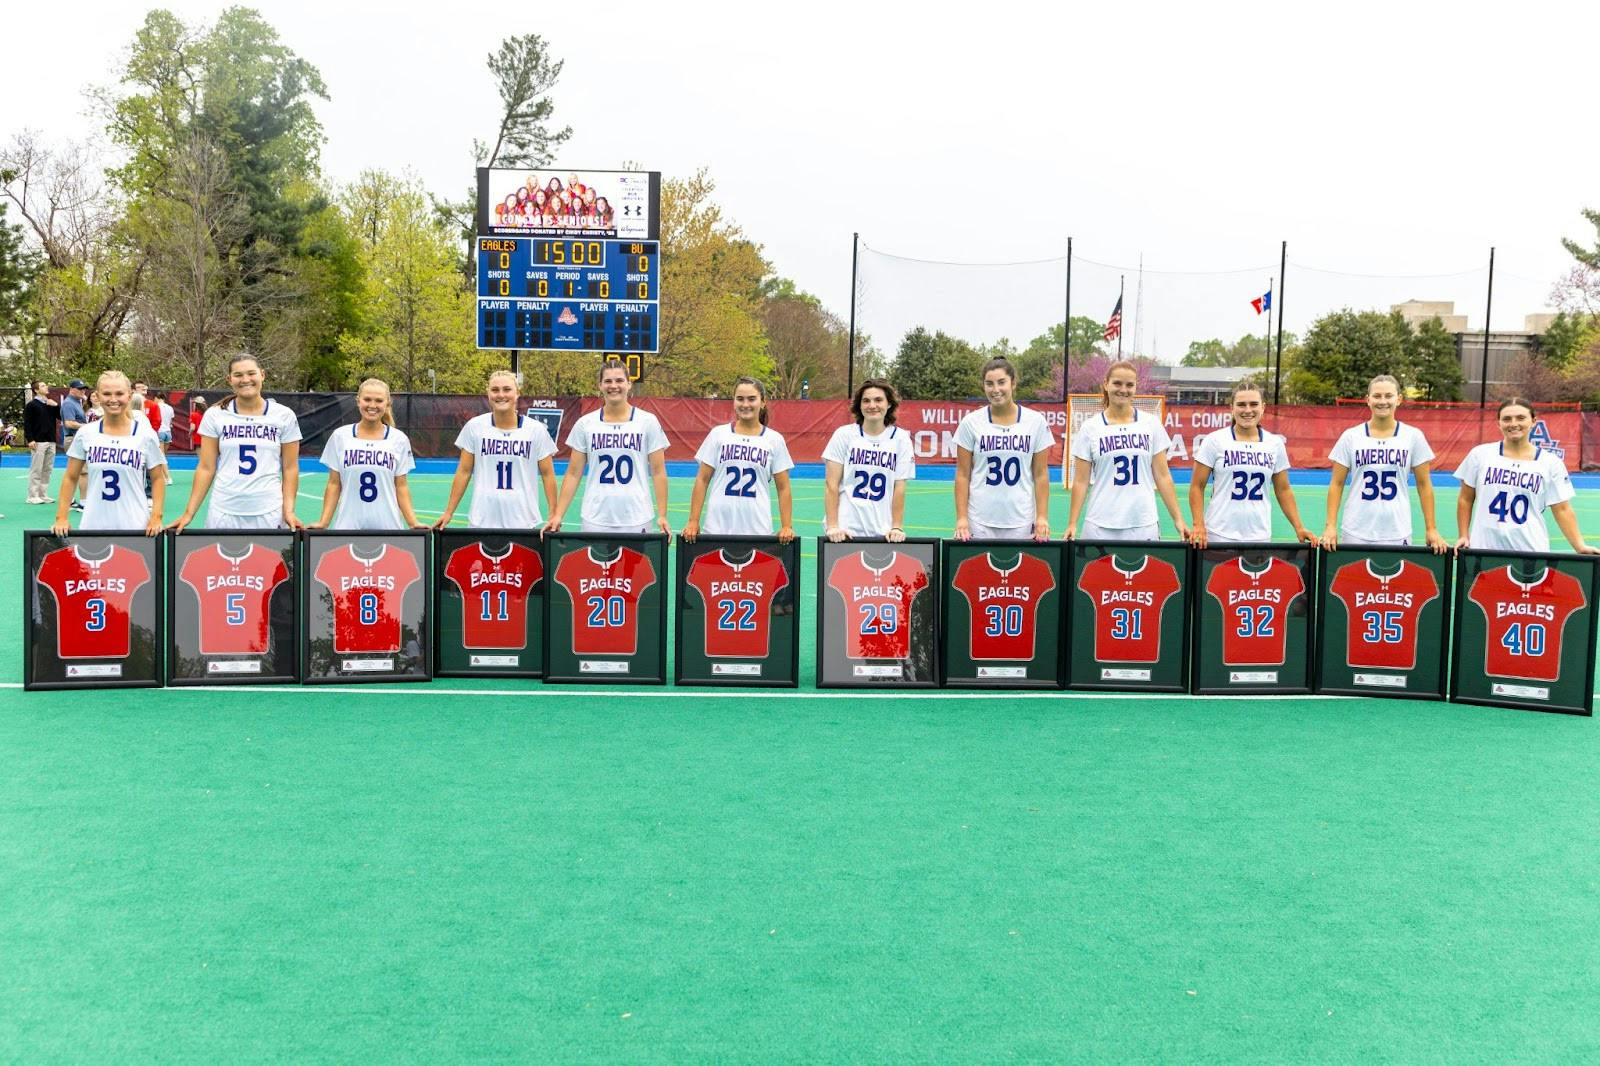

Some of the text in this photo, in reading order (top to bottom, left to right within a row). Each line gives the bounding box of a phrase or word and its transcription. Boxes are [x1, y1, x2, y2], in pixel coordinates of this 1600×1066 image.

[481, 240, 516, 251] EAGLES
[631, 243, 643, 254] BU
[500, 252, 510, 269] 0
[639, 255, 648, 272] 0
[488, 270, 510, 279] SHOTS
[526, 271, 548, 279] SAVES
[556, 272, 580, 280] PERIOD
[587, 272, 609, 280] SAVES
[626, 274, 649, 282] SHOTS
[500, 279, 510, 296] 0
[538, 280, 548, 296] 0
[599, 281, 609, 298] 0
[638, 282, 648, 299] 0
[481, 301, 510, 309] PLAYER
[517, 302, 550, 310] PENALTY
[580, 303, 609, 312] PLAYER
[616, 304, 649, 312] PENALTY
[533, 400, 557, 408] NCAA
[1191, 412, 1233, 428] COMP
[221, 425, 278, 442] AMERICAN
[591, 433, 642, 452] AMERICAN
[481, 438, 531, 460] AMERICAN
[980, 434, 1031, 454] AMERICAN
[1099, 434, 1150, 456] AMERICAN
[87, 446, 142, 470] AMERICAN
[239, 445, 257, 475] 5
[344, 449, 395, 470] AMERICAN
[719, 445, 770, 467] AMERICAN
[849, 448, 897, 471] AMERICAN
[1223, 450, 1275, 469] AMERICAN
[1355, 449, 1407, 468] AMERICAN
[496, 461, 513, 490] 11
[599, 454, 634, 485] 20
[985, 456, 1021, 487] 30
[1113, 455, 1139, 486] 31
[102, 469, 120, 501] 3
[359, 471, 378, 502] 8
[725, 466, 757, 498] 22
[852, 470, 886, 502] 29
[1231, 470, 1263, 501] 32
[1361, 470, 1397, 501] 35
[1484, 468, 1544, 495] AMERICAN
[1489, 491, 1529, 525] 40
[65, 578, 126, 596] EAGLES
[207, 575, 264, 591] EAGLES
[341, 575, 394, 591] EAGLES
[471, 572, 522, 588] EAGLES
[580, 578, 631, 594] EAGLES
[711, 581, 763, 597] EAGLES
[853, 586, 903, 601] EAGLES
[979, 586, 1029, 602] EAGLES
[1101, 590, 1153, 606] EAGLES
[1228, 589, 1281, 605] EAGLES
[1355, 592, 1413, 608] EAGLES
[86, 599, 105, 631] 3
[226, 593, 245, 625] 5
[359, 593, 378, 625] 8
[480, 590, 509, 621] 11
[587, 596, 625, 627] 20
[718, 599, 757, 631] 22
[1496, 602, 1554, 621] EAGLES
[860, 604, 897, 635] 29
[985, 605, 1024, 637] 30
[1111, 608, 1142, 640] 31
[1236, 605, 1274, 637] 32
[1362, 611, 1403, 643] 35
[1501, 623, 1546, 657] 40
